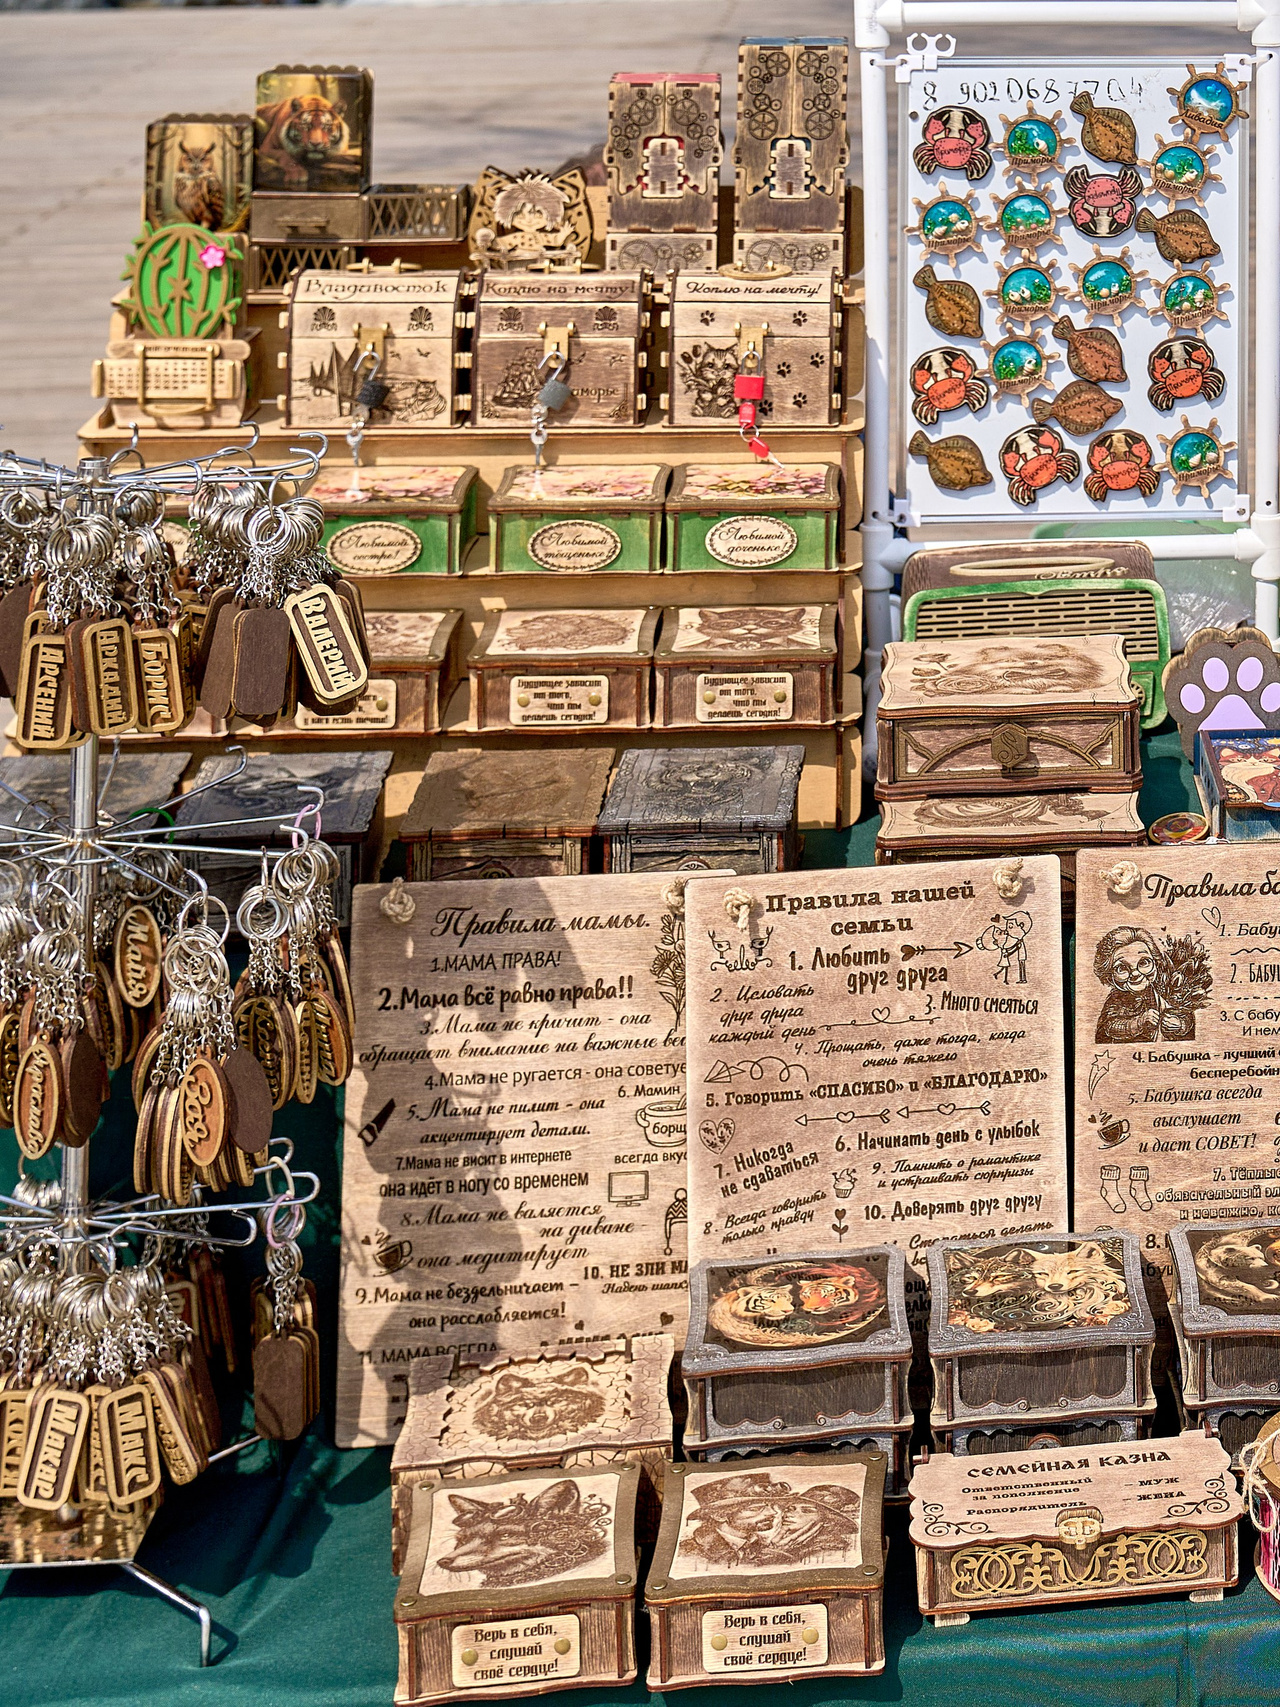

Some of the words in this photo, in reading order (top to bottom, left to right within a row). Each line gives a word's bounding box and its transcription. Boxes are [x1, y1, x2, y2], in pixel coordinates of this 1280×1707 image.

[1181, 109, 1224, 130] Ливадия
[1011, 156, 1056, 166] Приморье
[1154, 178, 1197, 195] Приморье
[928, 236, 972, 247] Приморье
[1007, 229, 1050, 243] Приморье
[305, 279, 449, 300] Владивосток
[485, 281, 541, 297] Коплю
[548, 285, 570, 295] на
[575, 280, 636, 298] мечту!
[686, 281, 740, 295] Коплю
[743, 285, 762, 295] на
[765, 281, 822, 298] мечту!
[1005, 305, 1051, 315] Приморье
[1090, 294, 1133, 311] Приморье
[1173, 306, 1216, 325] Приморье
[1179, 465, 1221, 482] Приморье
[339, 534, 409, 550] Любимой
[540, 531, 609, 549] Любимой
[718, 528, 787, 544] Любимой
[352, 549, 401, 562] сестре!
[726, 540, 787, 555] доченьке!
[765, 892, 881, 913] Правила
[891, 881, 976, 906] нашей
[1144, 871, 1257, 907] Правила
[430, 906, 557, 948] Правила
[561, 911, 651, 931] мамы.
[830, 918, 914, 936] семьи
[501, 952, 562, 970] ПРАВА!
[789, 951, 803, 971] 1.
[811, 946, 890, 971] Любить
[847, 971, 889, 995] друг
[897, 967, 948, 991] друга
[464, 984, 495, 1006] всё
[500, 982, 556, 1012] равно
[560, 976, 634, 1011] права!!
[1220, 1010, 1231, 1022] 3.
[1234, 1010, 1245, 1022] С
[706, 1093, 719, 1108] 5.
[724, 1090, 804, 1107] Говорить
[809, 1080, 904, 1099] «СПАСИБО»
[909, 1081, 919, 1092] и
[923, 1068, 1048, 1092] «БЛАГОДАРЮ»
[864, 1204, 886, 1220] 10.
[890, 1201, 964, 1222] Доверять
[969, 1199, 1000, 1218] друг
[1005, 1193, 1042, 1215] другу
[967, 1457, 1091, 1479] СЕМЕЙНАЯ
[1098, 1450, 1172, 1468] КАЗНА
[972, 1494, 988, 1502] за
[992, 1487, 1080, 1501] пополнение
[724, 1614, 757, 1630] Верь
[760, 1613, 770, 1625] в
[773, 1610, 806, 1627] себя,
[738, 1629, 792, 1647] слушай
[723, 1649, 754, 1667] своё
[757, 1646, 807, 1666] сердце!
